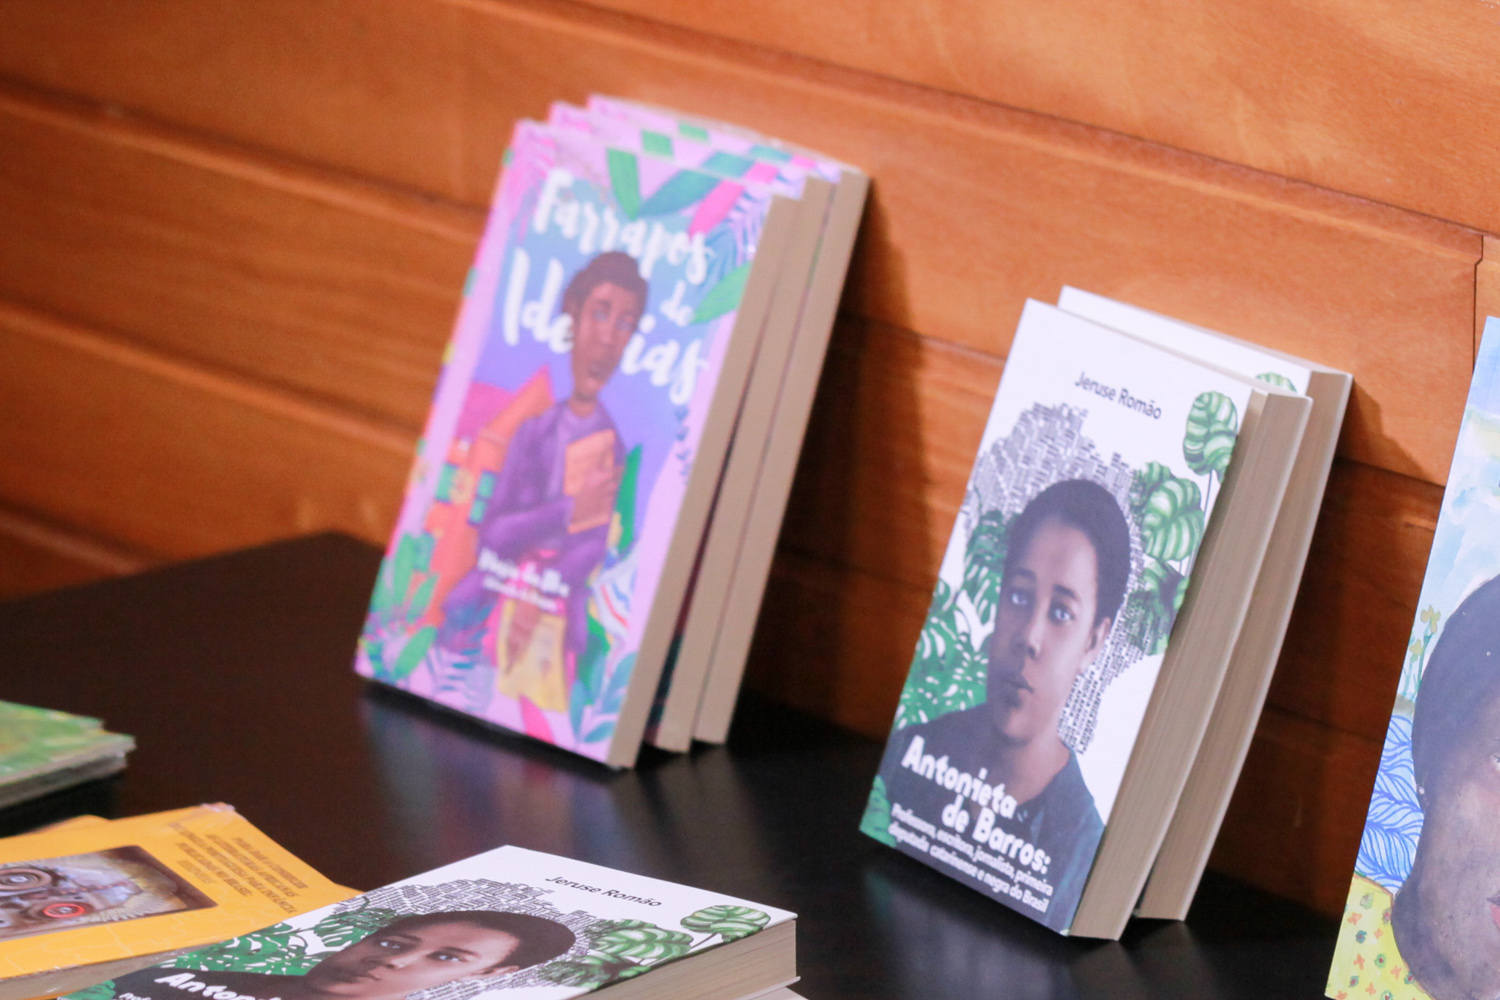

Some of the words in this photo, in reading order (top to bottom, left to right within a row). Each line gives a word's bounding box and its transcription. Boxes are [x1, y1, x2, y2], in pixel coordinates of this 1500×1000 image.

[533, 168, 716, 284] Farrapos
[1074, 371, 1116, 401] Jeruse
[1117, 387, 1162, 420] Romão
[901, 734, 1018, 820] Antonieta
[941, 794, 969, 833] de
[972, 807, 1051, 875] Barros:
[545, 876, 601, 893] Jeruse
[601, 889, 662, 906] Romão
[1009, 884, 1022, 900] do
[1022, 889, 1050, 913] Brasil
